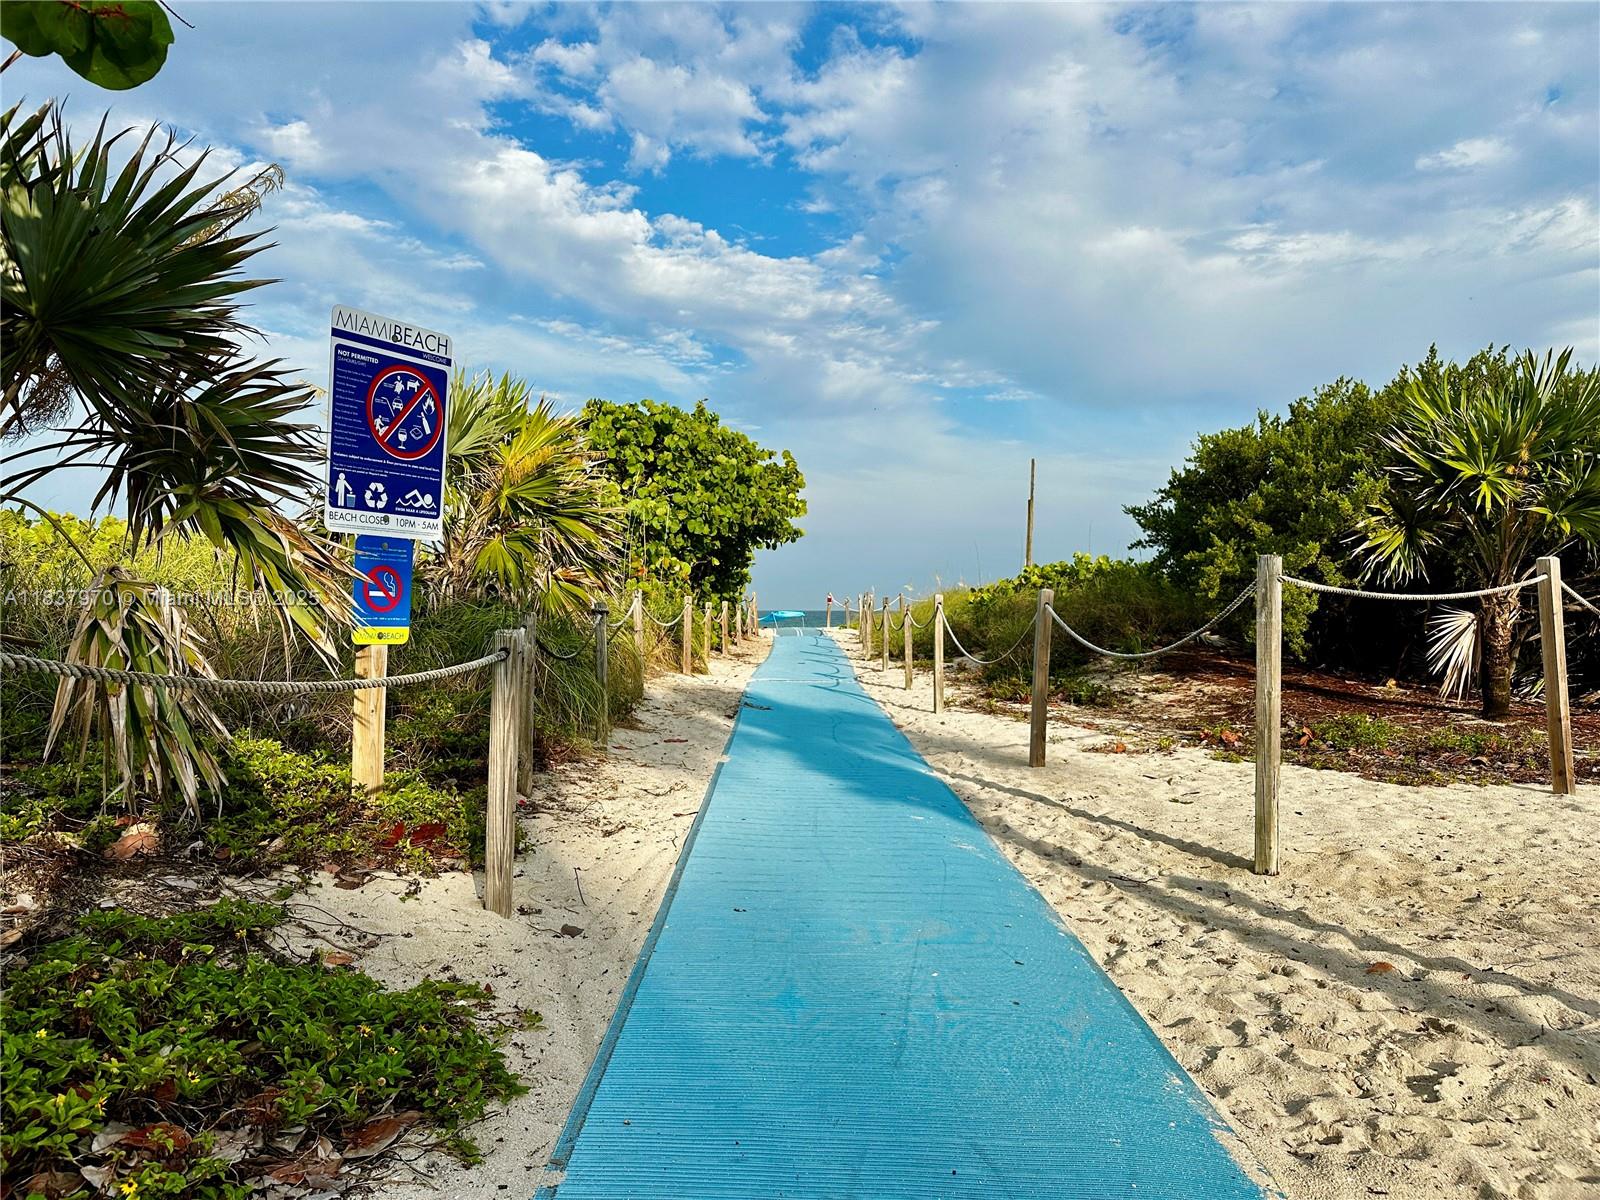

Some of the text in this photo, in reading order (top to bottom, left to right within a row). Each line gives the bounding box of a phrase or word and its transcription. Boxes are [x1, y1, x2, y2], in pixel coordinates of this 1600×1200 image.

[337, 349, 379, 364] NOT PERMITTED
[422, 352, 447, 365] WELCOME
[329, 511, 357, 522] BEACH
[395, 517, 416, 528] 10PM
[422, 521, 439, 530] 5AM
